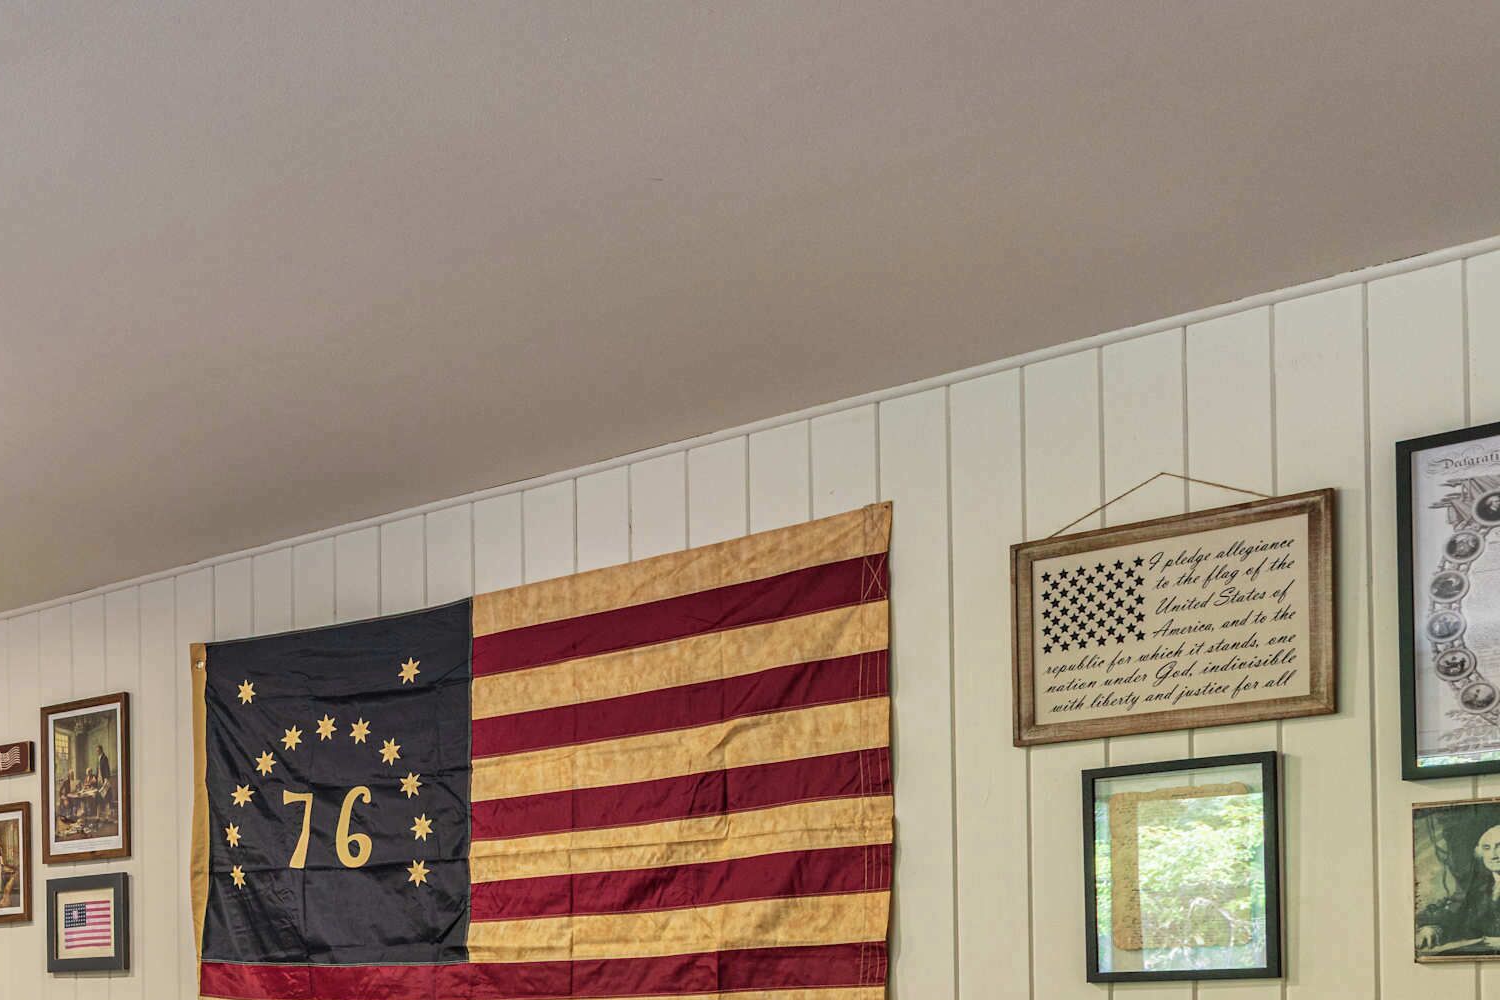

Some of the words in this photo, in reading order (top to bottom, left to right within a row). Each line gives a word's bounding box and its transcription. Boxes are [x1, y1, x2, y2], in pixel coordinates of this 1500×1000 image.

[1149, 551, 1164, 571] I
[1160, 547, 1211, 573] pledge
[1215, 539, 1295, 562] allegiance
[1155, 576, 1169, 590] to
[1174, 569, 1201, 587] the
[1202, 564, 1240, 589] flag
[1244, 557, 1268, 582] of
[1268, 553, 1296, 572] the
[1155, 592, 1215, 615] United
[1213, 586, 1266, 607] States
[1270, 579, 1296, 604] of
[1152, 618, 1215, 639] America,
[1220, 609, 1254, 629] and
[1252, 610, 1268, 625] to
[1272, 604, 1296, 621] the
[1044, 654, 1105, 678] republic
[1106, 649, 1132, 674] for
[1137, 641, 1186, 663] which
[1187, 642, 1205, 656] it
[1205, 632, 1259, 654] stands,
[1267, 634, 1297, 646] one
[1045, 678, 1098, 693] nation
[1102, 668, 1148, 687] under
[1152, 660, 1198, 687] God,
[1201, 647, 1298, 674] indivisible
[1050, 694, 1088, 713] with
[1088, 691, 1141, 712] liberty
[1142, 684, 1180, 703] and
[1172, 682, 1231, 706] justice
[1231, 674, 1260, 699] for
[1262, 669, 1298, 689] all
[282, 785, 373, 870] 76
